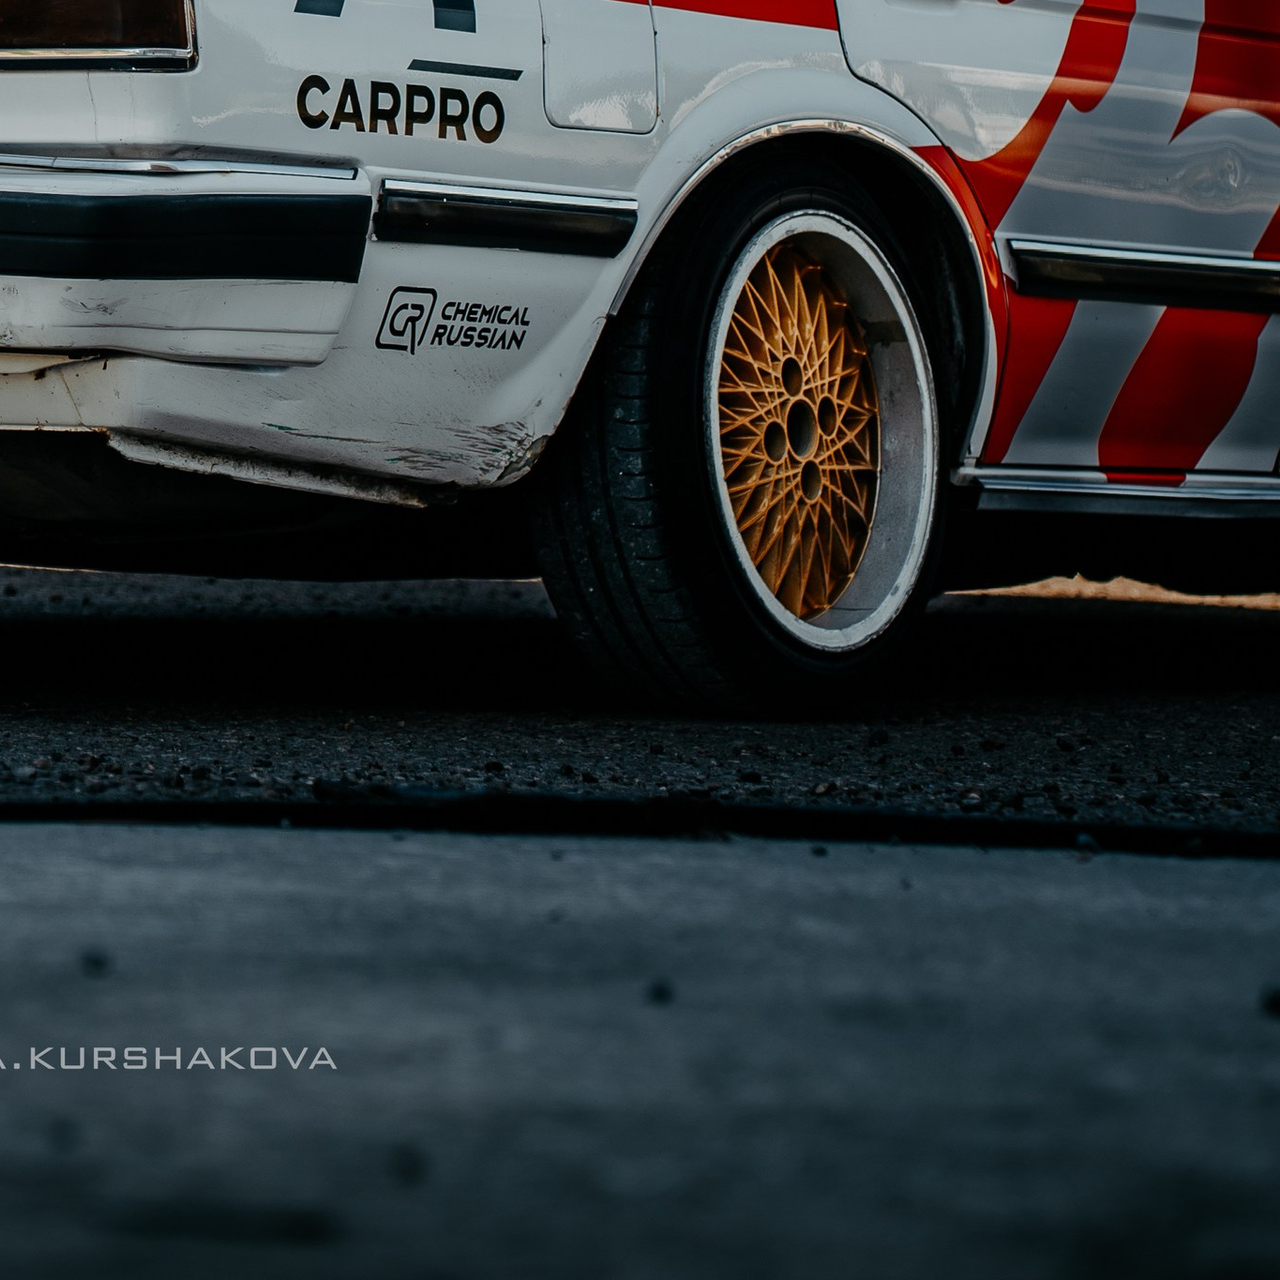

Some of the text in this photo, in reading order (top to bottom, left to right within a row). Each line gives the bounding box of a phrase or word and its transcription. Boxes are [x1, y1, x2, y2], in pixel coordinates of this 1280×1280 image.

[297, 74, 505, 144] CARPRO
[441, 302, 531, 327] CHEMICAL
[430, 324, 527, 351] RUSSIAN
